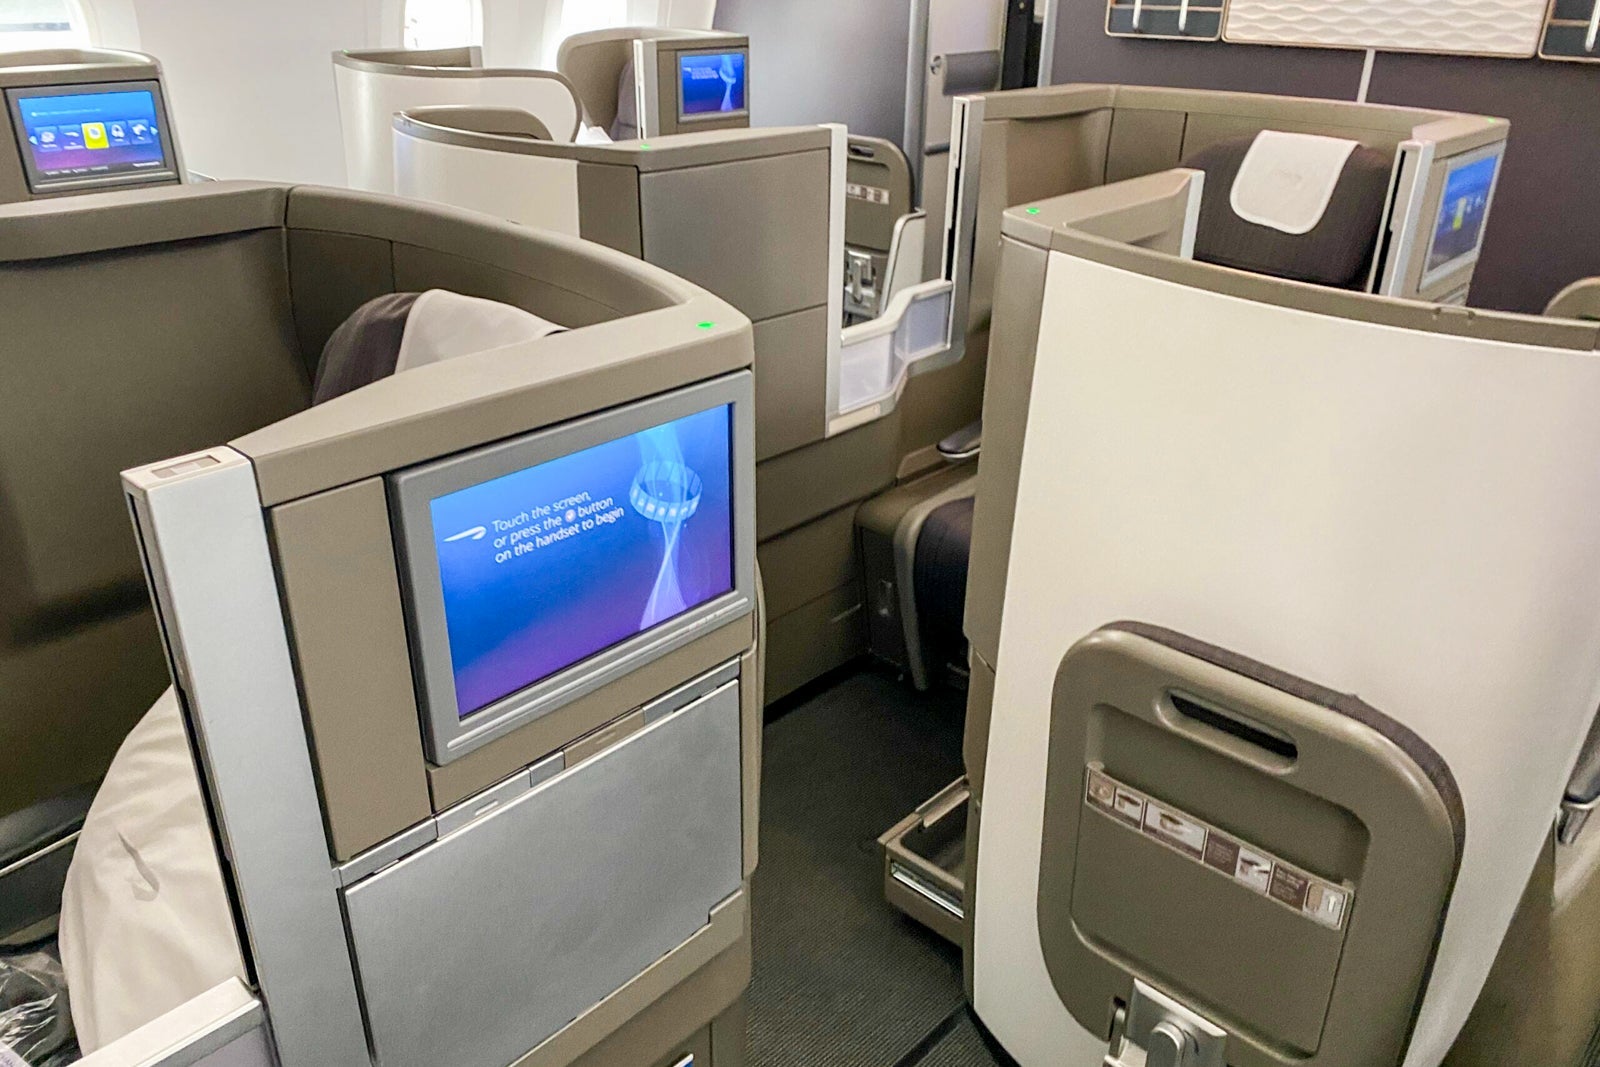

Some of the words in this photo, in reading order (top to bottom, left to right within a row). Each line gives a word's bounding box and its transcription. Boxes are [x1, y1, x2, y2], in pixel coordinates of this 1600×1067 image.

[492, 512, 529, 532] Touch
[531, 505, 551, 519] the
[493, 535, 508, 549] or
[510, 523, 541, 545] press
[543, 516, 563, 530] the
[577, 497, 613, 518] button
[495, 549, 512, 564] on
[514, 541, 535, 557] the
[536, 523, 580, 549] handset
[581, 518, 595, 531] to
[595, 506, 625, 524] begin
